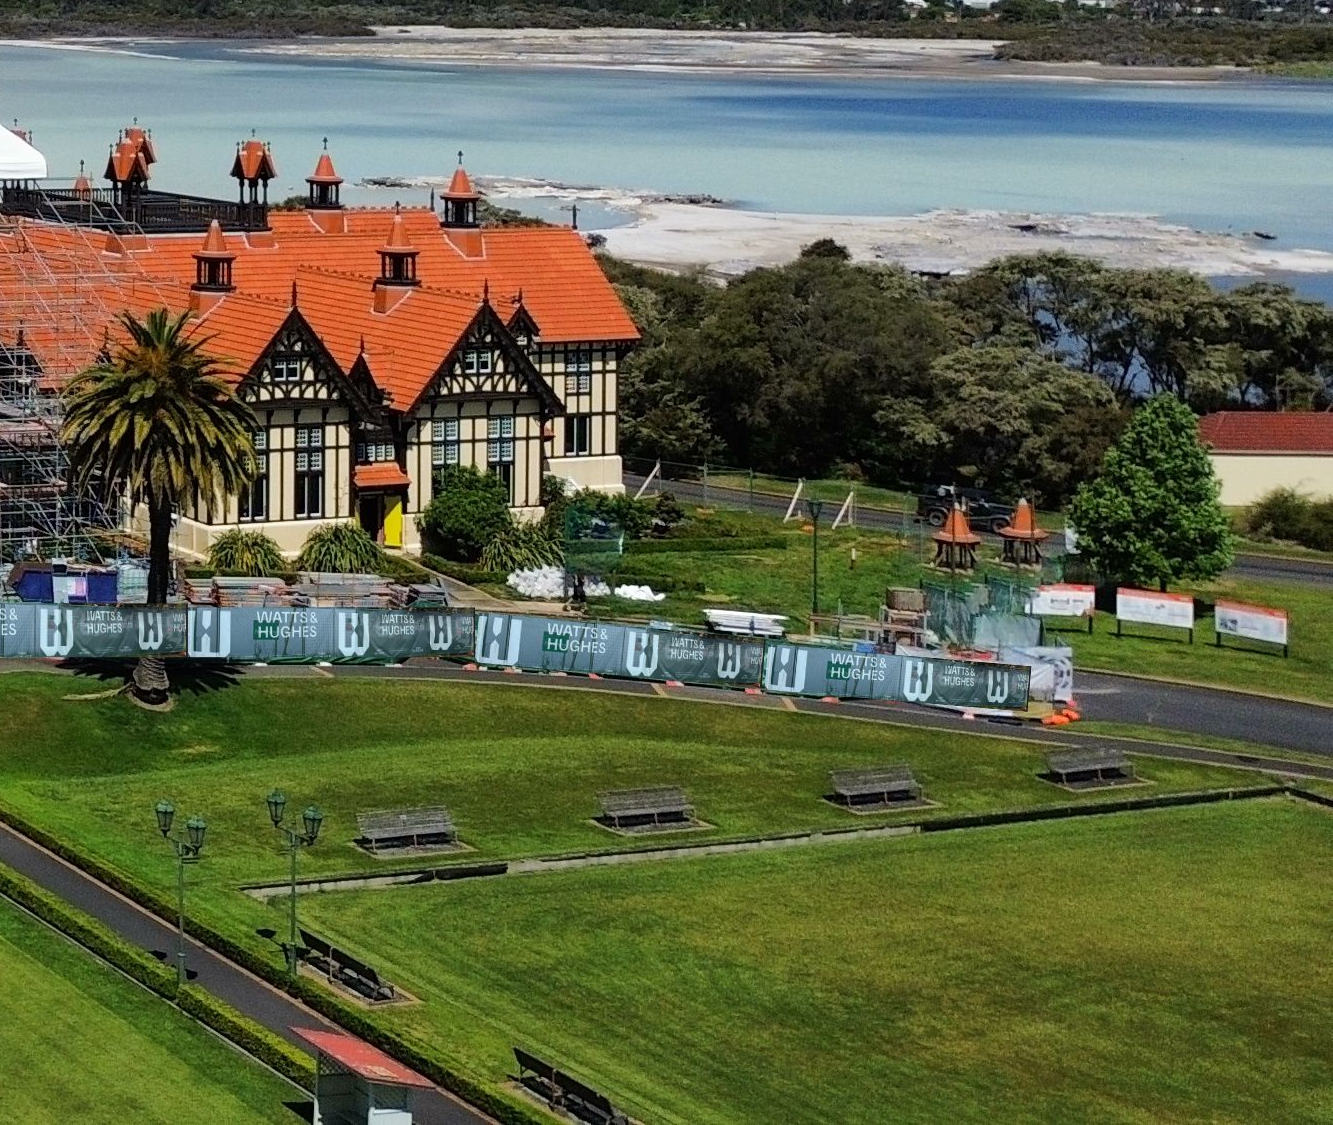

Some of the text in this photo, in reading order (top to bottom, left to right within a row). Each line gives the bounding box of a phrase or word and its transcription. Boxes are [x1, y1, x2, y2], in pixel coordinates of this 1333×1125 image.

[87, 610, 116, 621] WATTS
[256, 611, 308, 623] WATTS
[381, 614, 408, 623] WATTS
[87, 623, 122, 634] HUGHES
[258, 625, 317, 638] HUGHES
[381, 625, 415, 635] HUGHES
[547, 622, 598, 636] WATTS
[547, 637, 606, 653] HUGHES
[671, 637, 698, 649] WATTS
[670, 649, 703, 660] HUGHES
[831, 653, 877, 667] WATTS
[830, 666, 885, 681] HUGHES
[944, 665, 969, 676] WATTS
[944, 676, 975, 687] HUGHES
